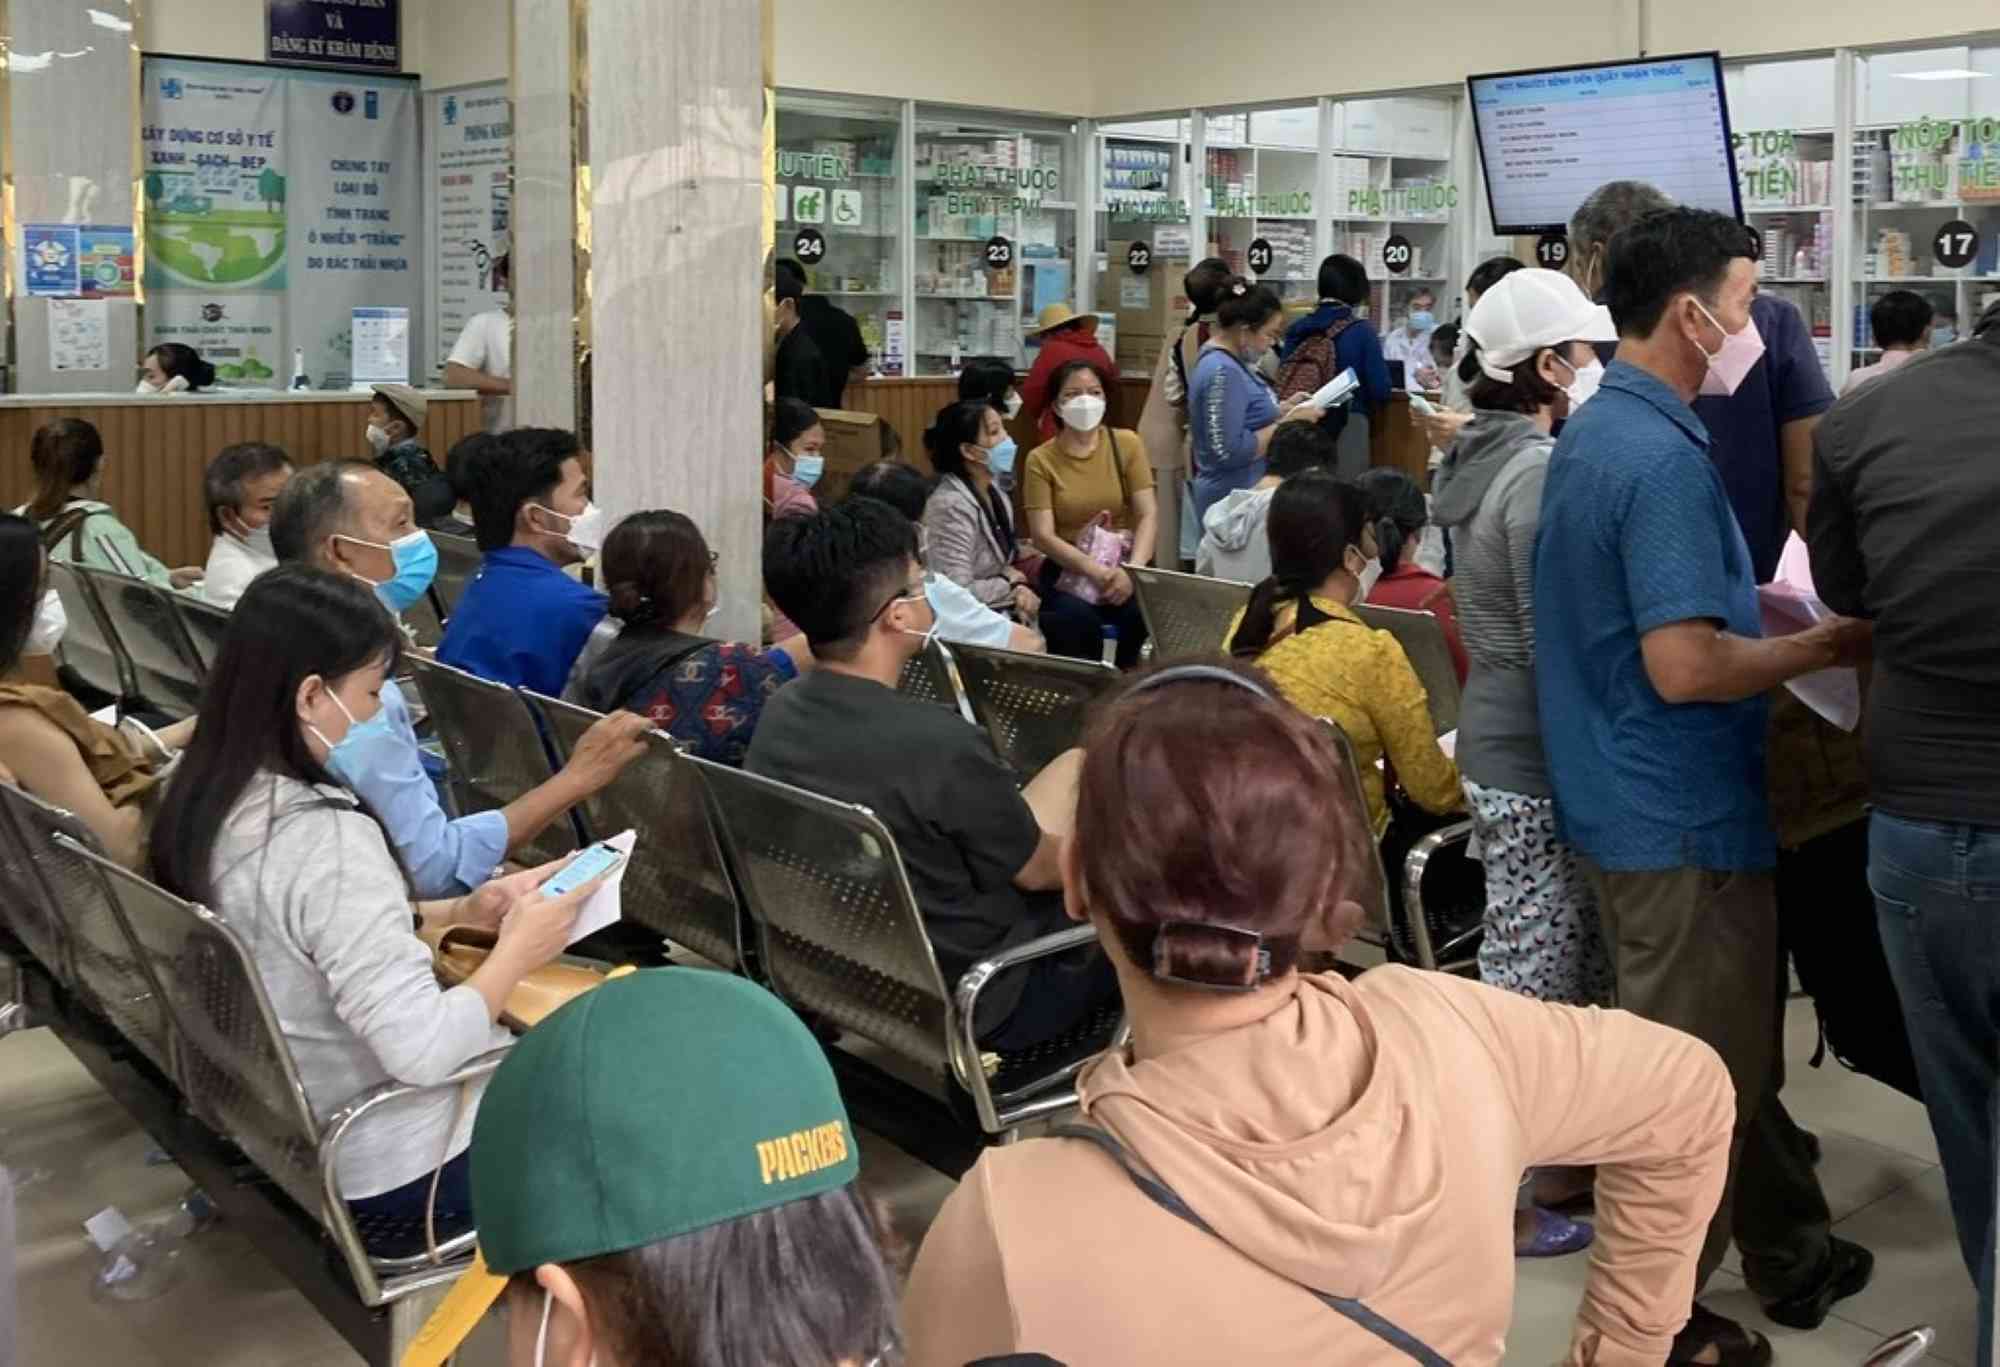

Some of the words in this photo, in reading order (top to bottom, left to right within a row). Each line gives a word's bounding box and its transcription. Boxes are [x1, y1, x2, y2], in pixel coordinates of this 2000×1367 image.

[1961, 117, 2000, 145] TO
[1898, 162, 1949, 192] THU
[797, 238, 822, 255] 24
[988, 245, 1010, 261] 23
[1540, 242, 1566, 261] 19
[1939, 233, 1974, 255] 17
[1130, 249, 1150, 265] 22
[1250, 247, 1269, 265] 21
[1386, 246, 1409, 263] 20
[755, 1119, 849, 1185] PACKERS
